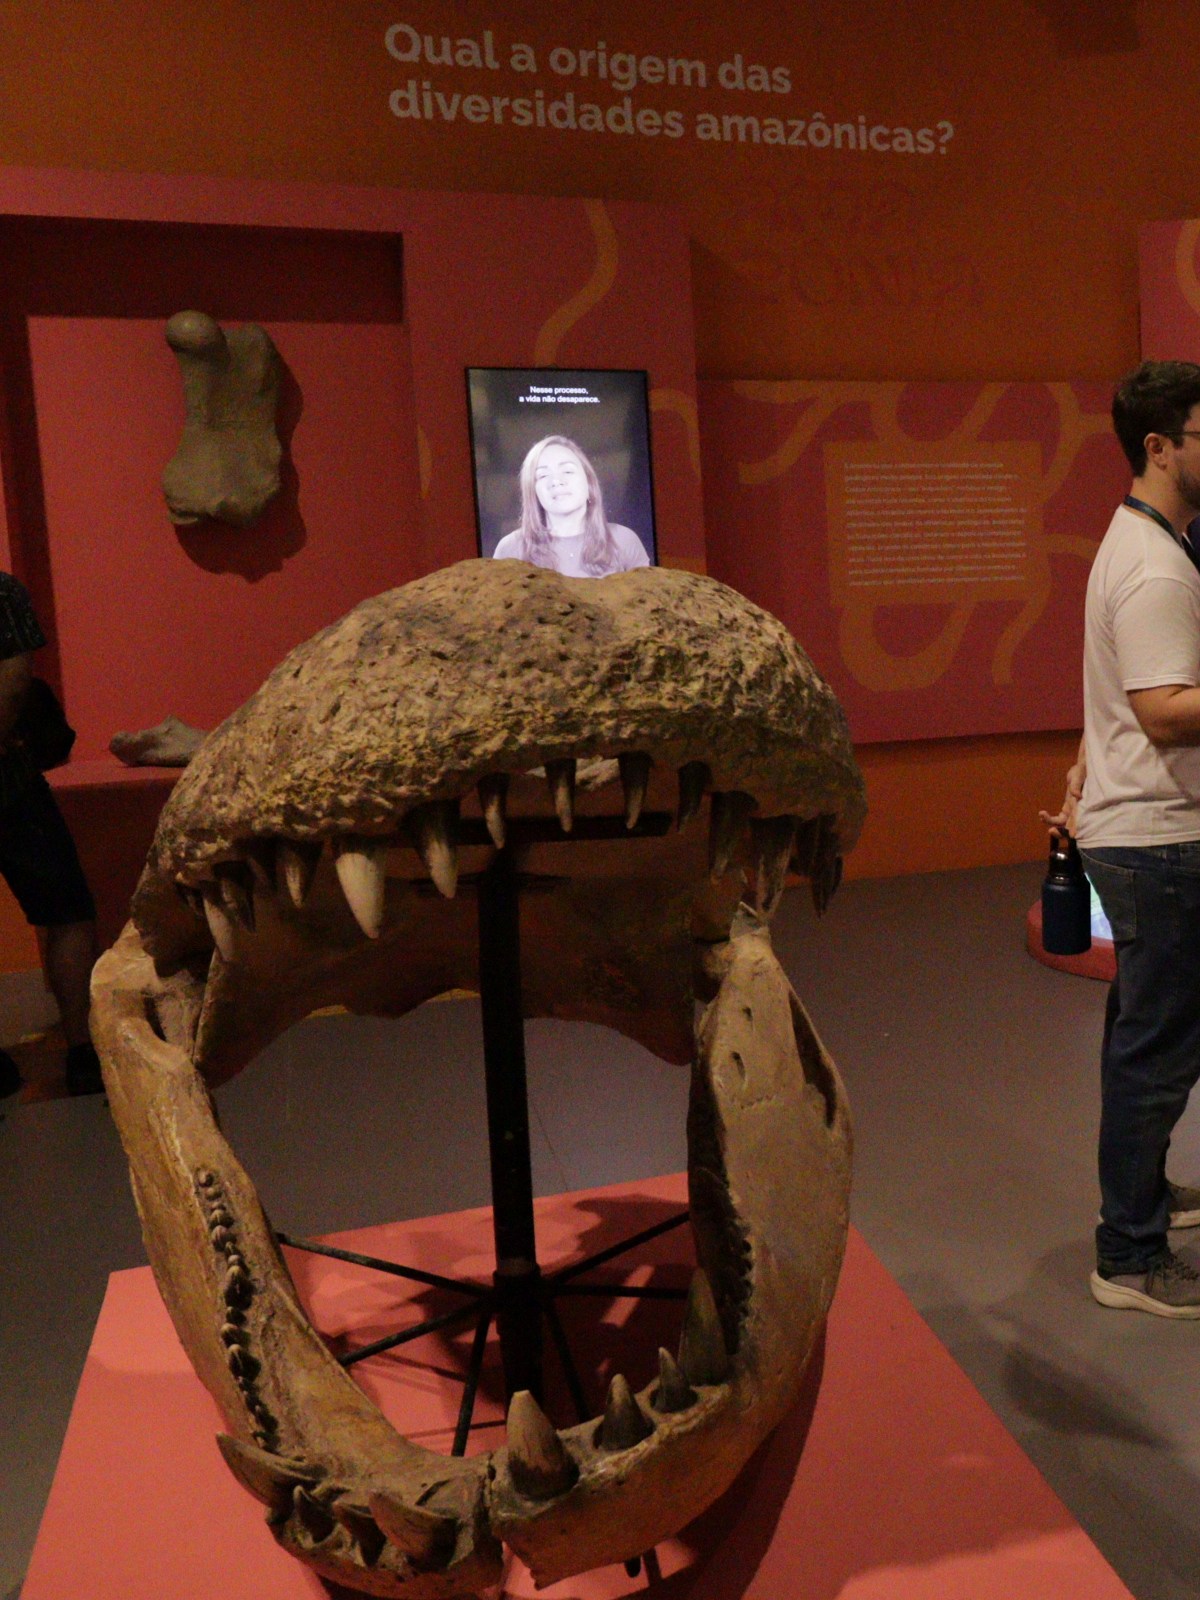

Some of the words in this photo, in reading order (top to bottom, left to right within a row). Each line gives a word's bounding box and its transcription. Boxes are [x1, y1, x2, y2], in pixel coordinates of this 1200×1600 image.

[384, 23, 500, 70] Qual
[510, 43, 537, 73] a
[550, 41, 707, 91] origem
[717, 53, 793, 95] das
[388, 80, 686, 138] diversidades
[695, 112, 955, 155] amazônicas?
[525, 395, 541, 403] vida
[542, 395, 556, 403] não
[530, 386, 553, 394] Nesse
[554, 387, 588, 395] processo,
